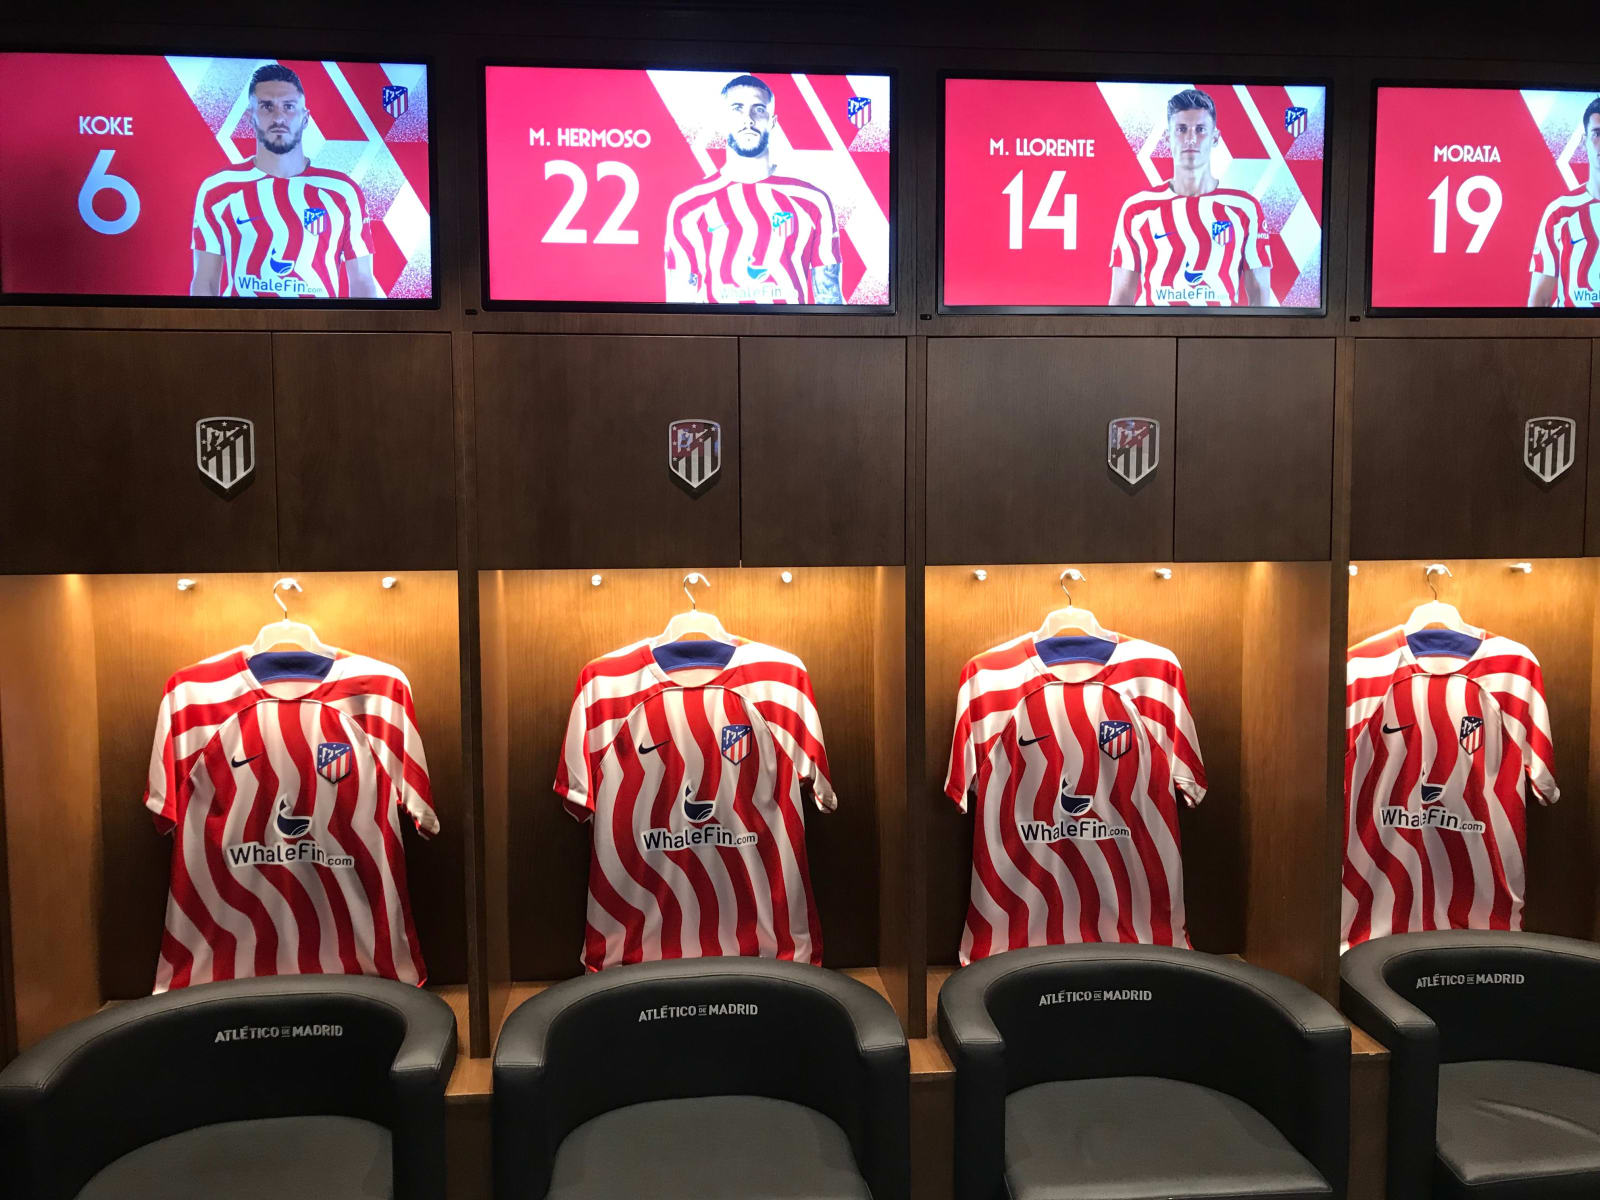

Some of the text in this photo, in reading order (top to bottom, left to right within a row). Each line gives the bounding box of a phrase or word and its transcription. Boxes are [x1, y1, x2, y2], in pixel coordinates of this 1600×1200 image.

[79, 115, 134, 136] KOKE
[529, 127, 651, 149] M. HERMOSO
[989, 138, 1095, 158] M. LLORENTE
[1433, 144, 1501, 163] MORATA
[77, 149, 141, 235] 6
[540, 159, 640, 245] 22
[1002, 169, 1078, 250] 14
[1427, 175, 1503, 254] 19
[643, 826, 756, 851] WhaleFin.com
[1020, 820, 1130, 841] WhaleFin.com
[229, 842, 352, 866] WhaleFin.com
[1416, 973, 1466, 989] ATLÉTICO
[1476, 973, 1525, 985] MADRID
[1039, 989, 1092, 1006] ATLÉTICO
[1103, 989, 1152, 1001] MADRID
[638, 1005, 698, 1022] ATLÉTICO
[708, 1003, 758, 1016] MADRID
[214, 1025, 280, 1043] ATLÉTICO
[292, 1024, 343, 1037] MADRID
